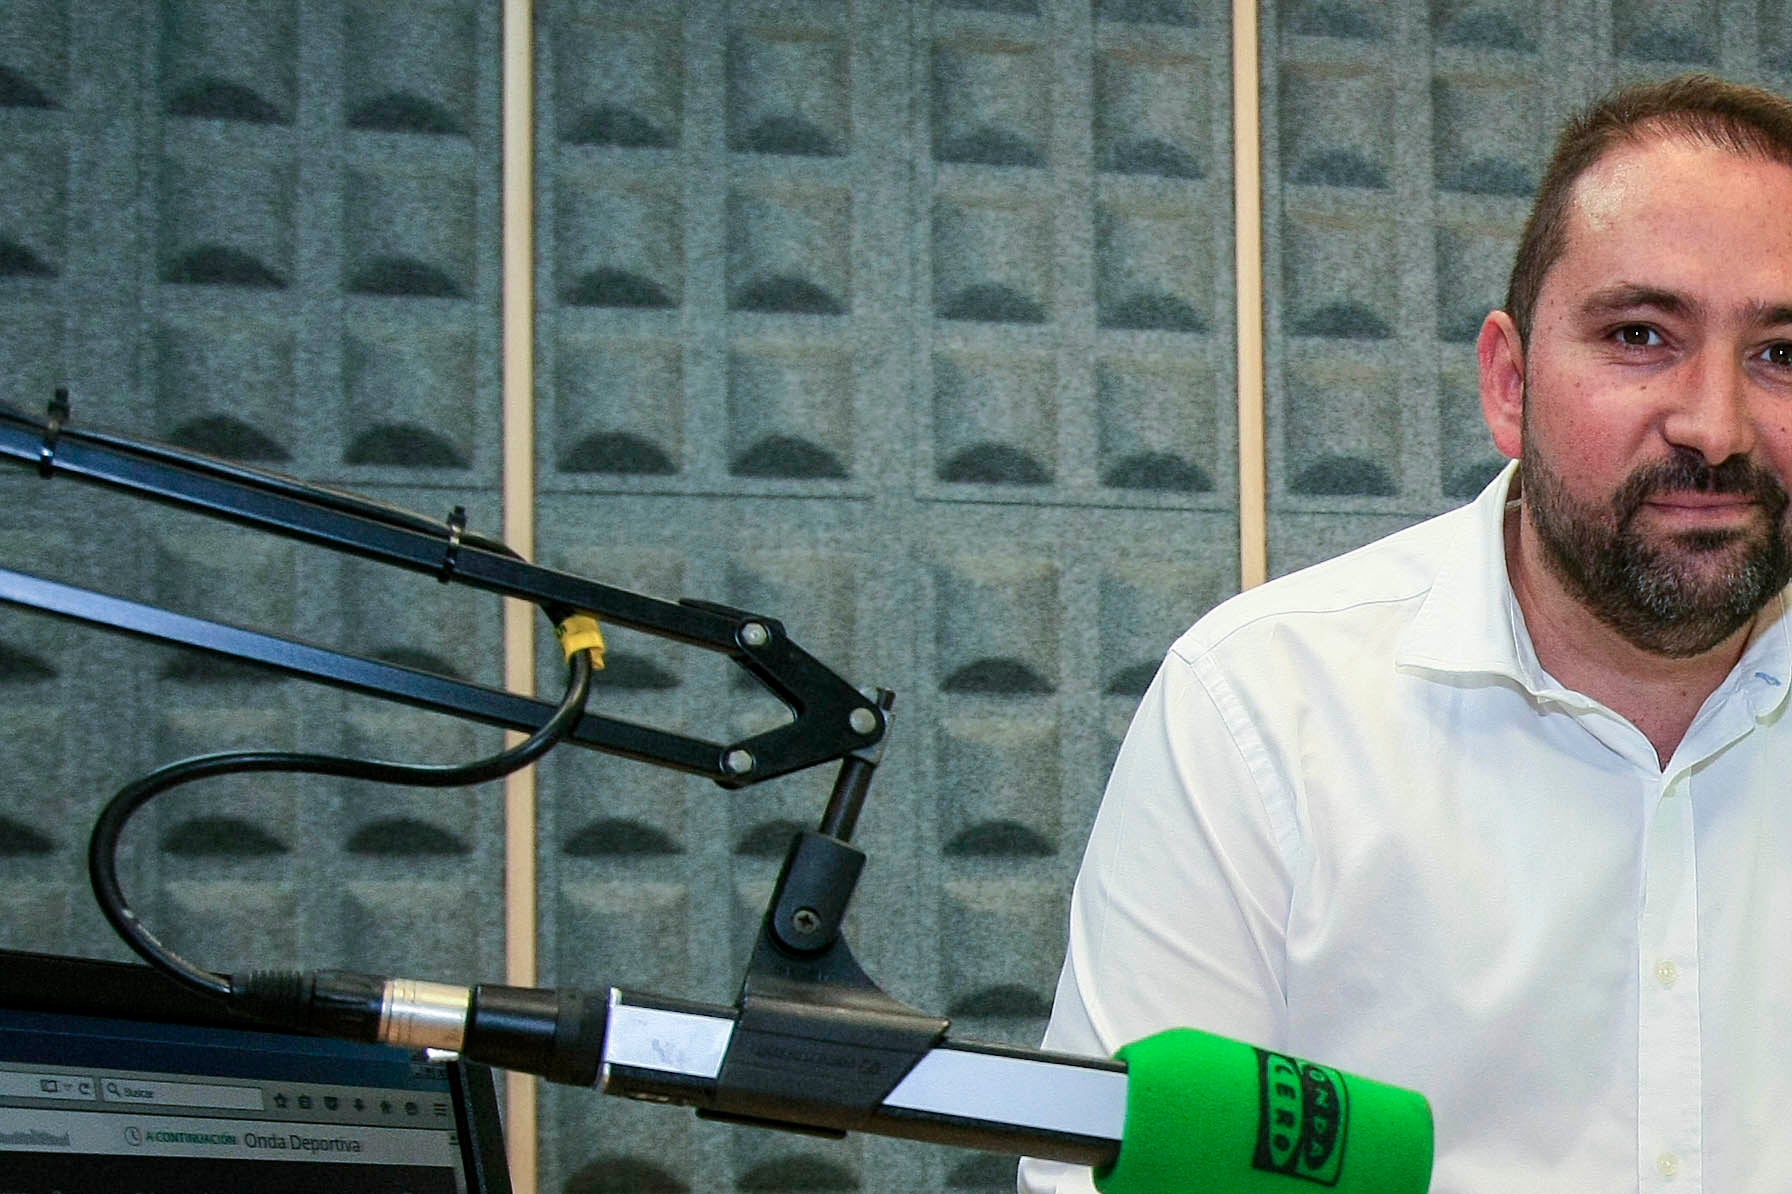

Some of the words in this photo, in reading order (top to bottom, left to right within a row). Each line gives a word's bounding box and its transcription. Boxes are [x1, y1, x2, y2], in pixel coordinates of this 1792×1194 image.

[245, 1132, 287, 1149] Onda
[291, 1134, 360, 1154] Deportiva
[1273, 1064, 1297, 1152] CERO
[1308, 1068, 1330, 1157] ONDA
